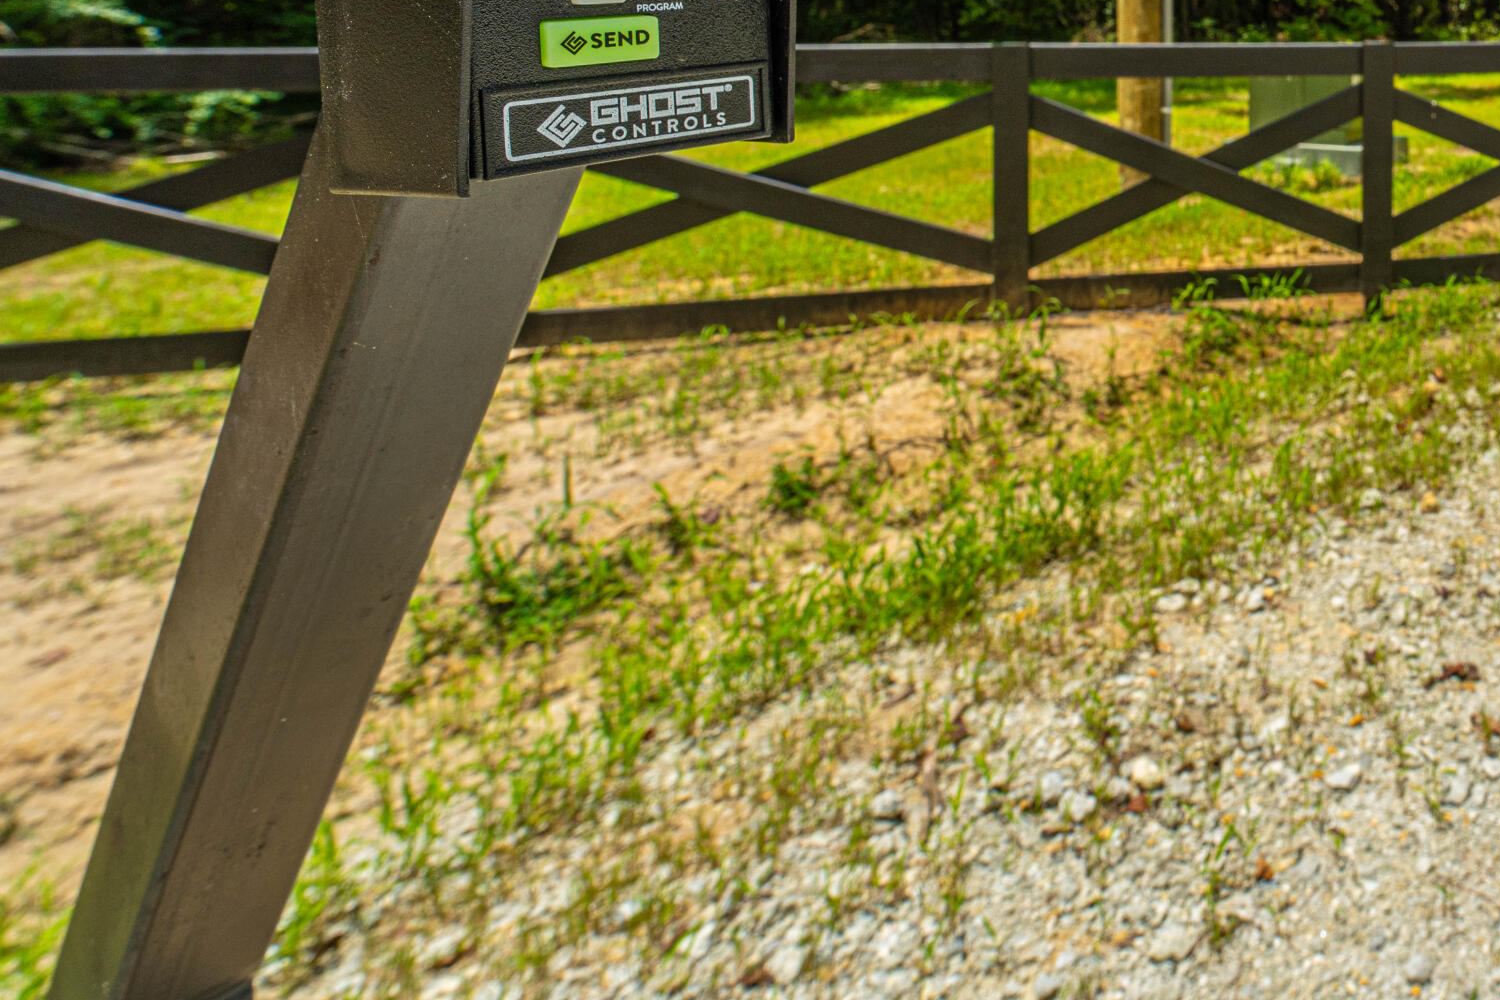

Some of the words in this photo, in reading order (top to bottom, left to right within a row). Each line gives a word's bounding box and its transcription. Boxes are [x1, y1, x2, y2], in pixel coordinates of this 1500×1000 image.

[636, 2, 683, 12] PROGRAM
[591, 30, 650, 49] SEND
[590, 85, 725, 126] GHOST
[591, 112, 727, 144] CONTROLS
